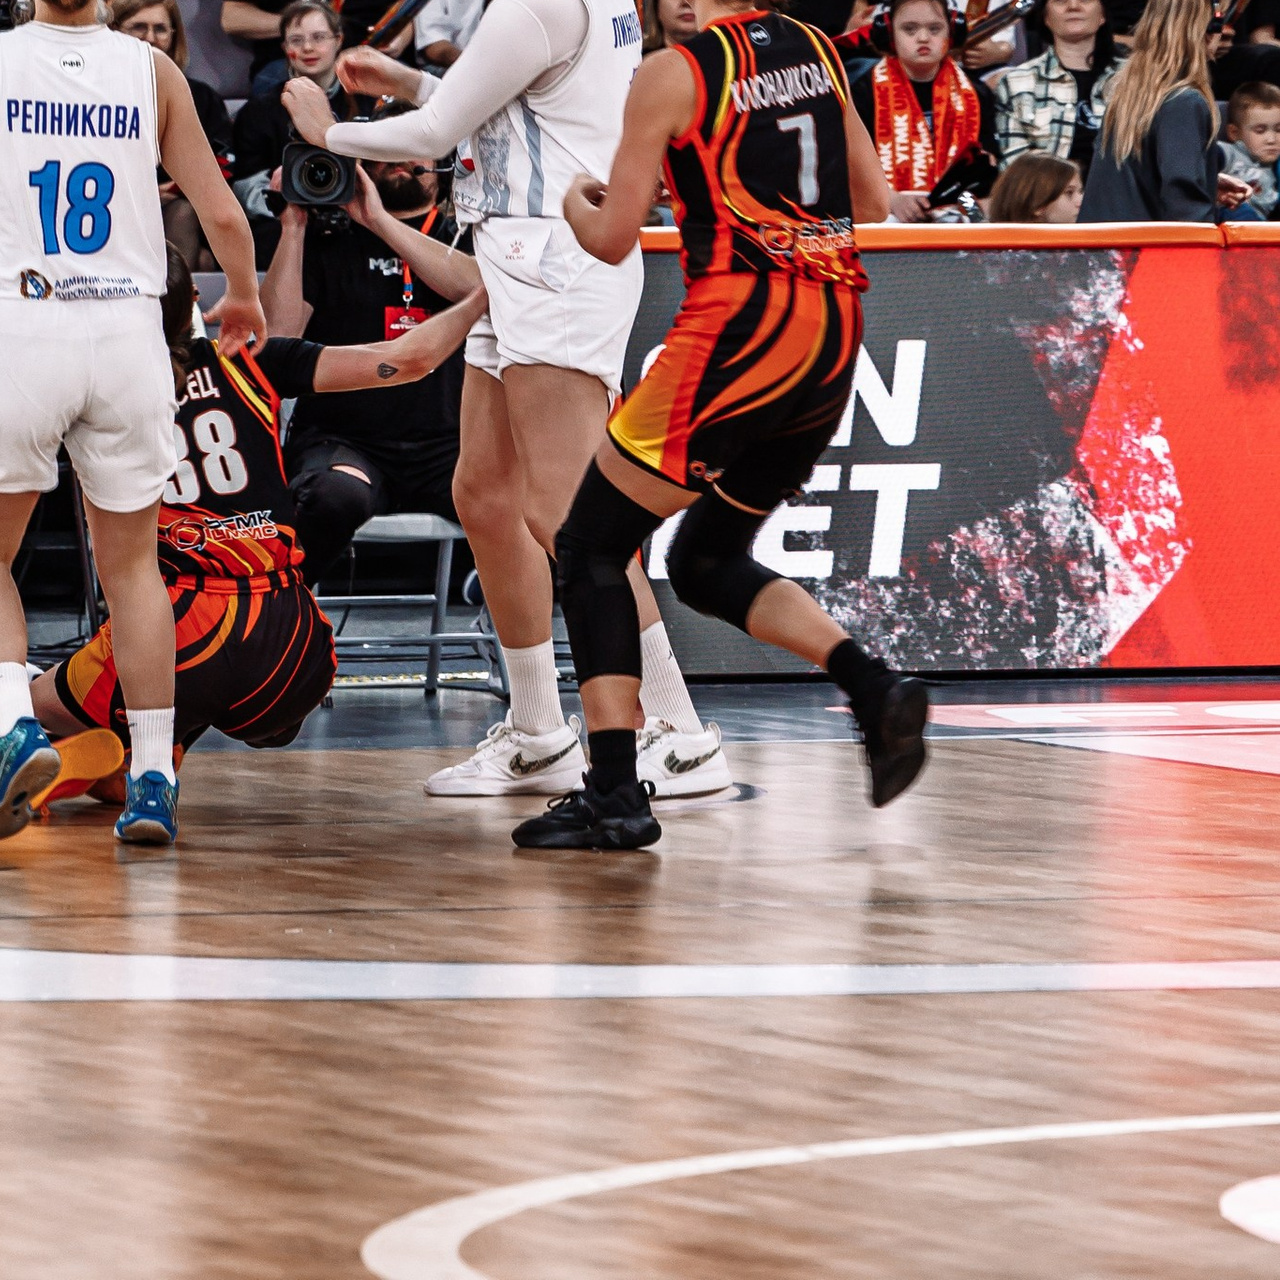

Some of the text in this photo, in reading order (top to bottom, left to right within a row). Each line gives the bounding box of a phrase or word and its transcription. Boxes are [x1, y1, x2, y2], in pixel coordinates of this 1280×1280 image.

[6, 98, 140, 140] РЕПНИКОВА
[776, 111, 820, 208] 7
[28, 159, 115, 256] 18
